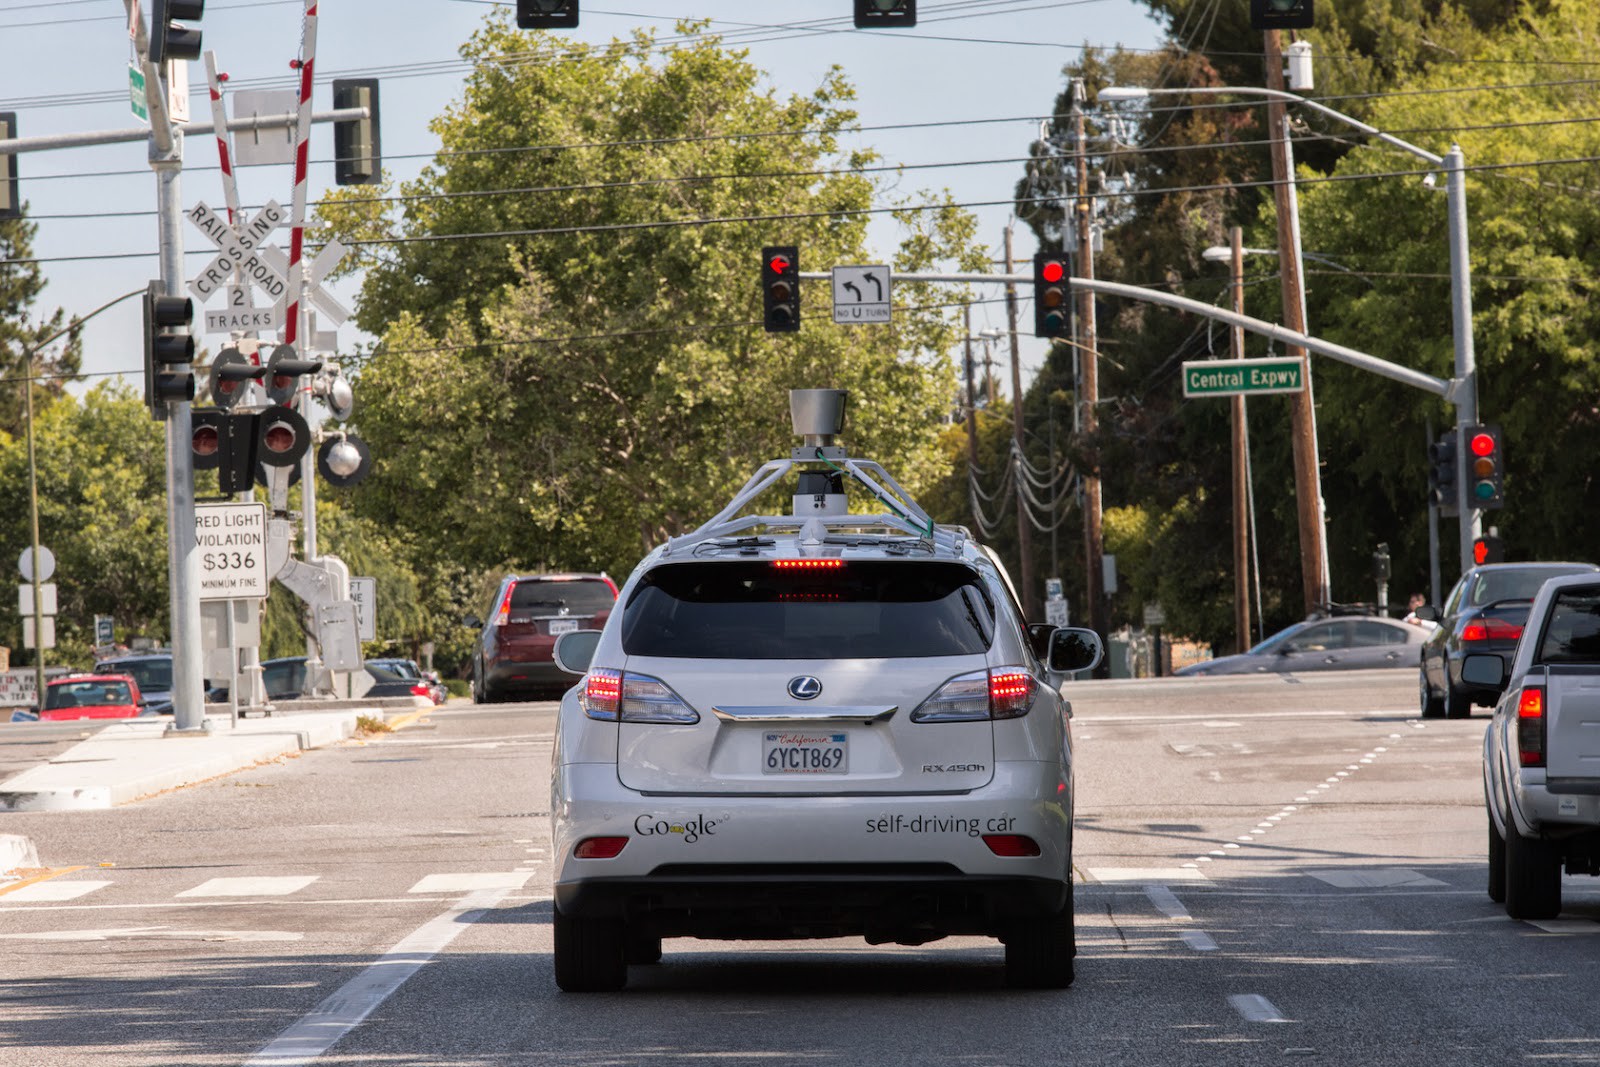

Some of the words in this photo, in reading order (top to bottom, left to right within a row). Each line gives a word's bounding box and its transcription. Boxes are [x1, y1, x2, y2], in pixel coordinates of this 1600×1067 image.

[191, 206, 227, 245] RAIL
[243, 256, 284, 296] ROAD
[197, 208, 279, 294] CROSSING
[233, 289, 245, 306] 2
[208, 313, 271, 328] TRACKS
[837, 309, 850, 318] NO
[852, 307, 862, 319] U
[865, 308, 889, 318] TURN
[1190, 370, 1244, 388] Central
[1250, 368, 1298, 388] Expwy
[195, 515, 220, 528] RED
[225, 513, 261, 527] LIGHT
[195, 533, 261, 547] VIOLATION
[203, 551, 256, 573] $336
[201, 579, 236, 589] MINIMUM
[239, 578, 257, 588] FINE
[780, 732, 831, 747] California
[767, 747, 843, 768] 6YCT869
[922, 764, 945, 773] RX
[946, 764, 985, 772] 450h
[866, 814, 981, 838] self-driving
[986, 816, 1017, 832] car
